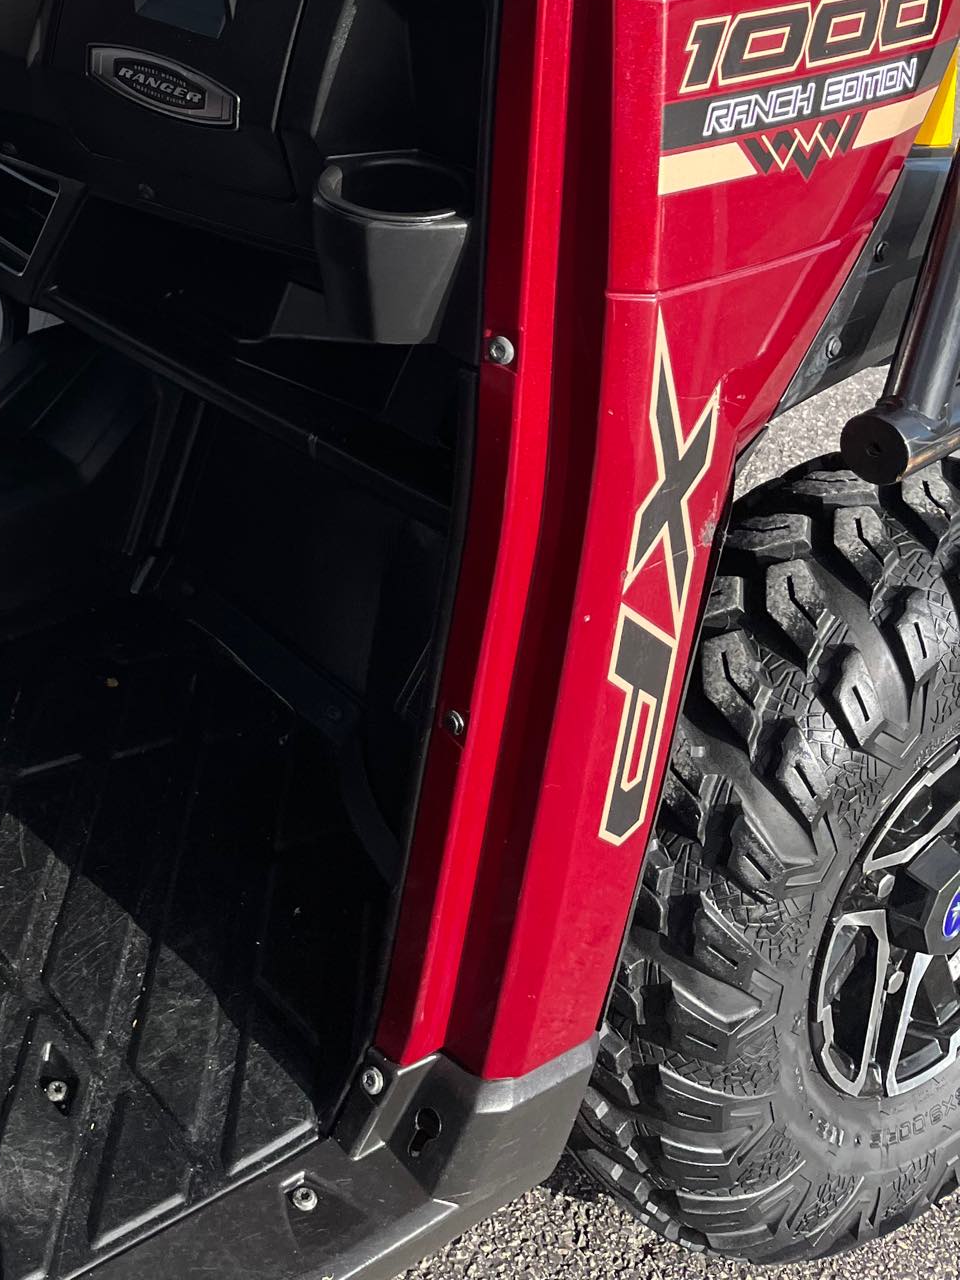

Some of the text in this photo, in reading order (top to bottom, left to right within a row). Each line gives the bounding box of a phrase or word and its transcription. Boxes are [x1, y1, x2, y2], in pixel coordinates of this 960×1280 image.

[118, 67, 202, 103] RANGER
[702, 57, 918, 136] RANCH EDITION
[598, 303, 722, 847] XP
